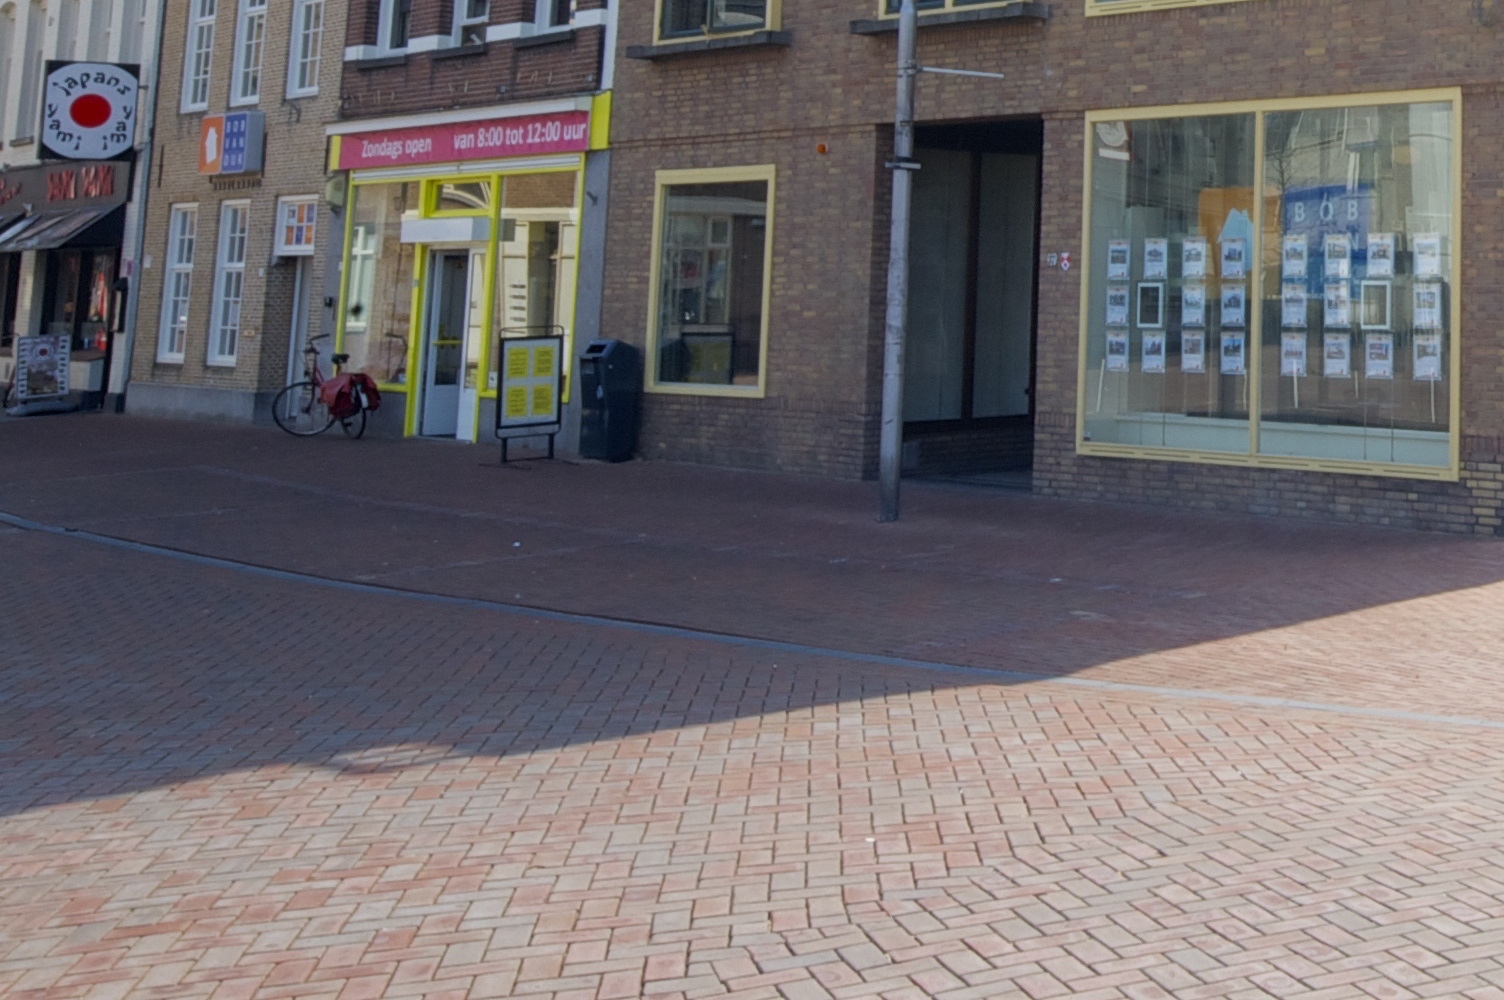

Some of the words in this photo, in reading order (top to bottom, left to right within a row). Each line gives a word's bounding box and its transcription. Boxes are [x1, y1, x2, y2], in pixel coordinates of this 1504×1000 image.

[52, 72, 131, 96] japans
[361, 139, 402, 159] Zondags
[405, 137, 432, 157] open
[453, 133, 475, 149] van
[477, 127, 503, 147] 8:00
[505, 128, 524, 145] tot
[526, 121, 560, 143] 12:00
[563, 122, 587, 141] uur
[1294, 200, 1358, 222] BOB
